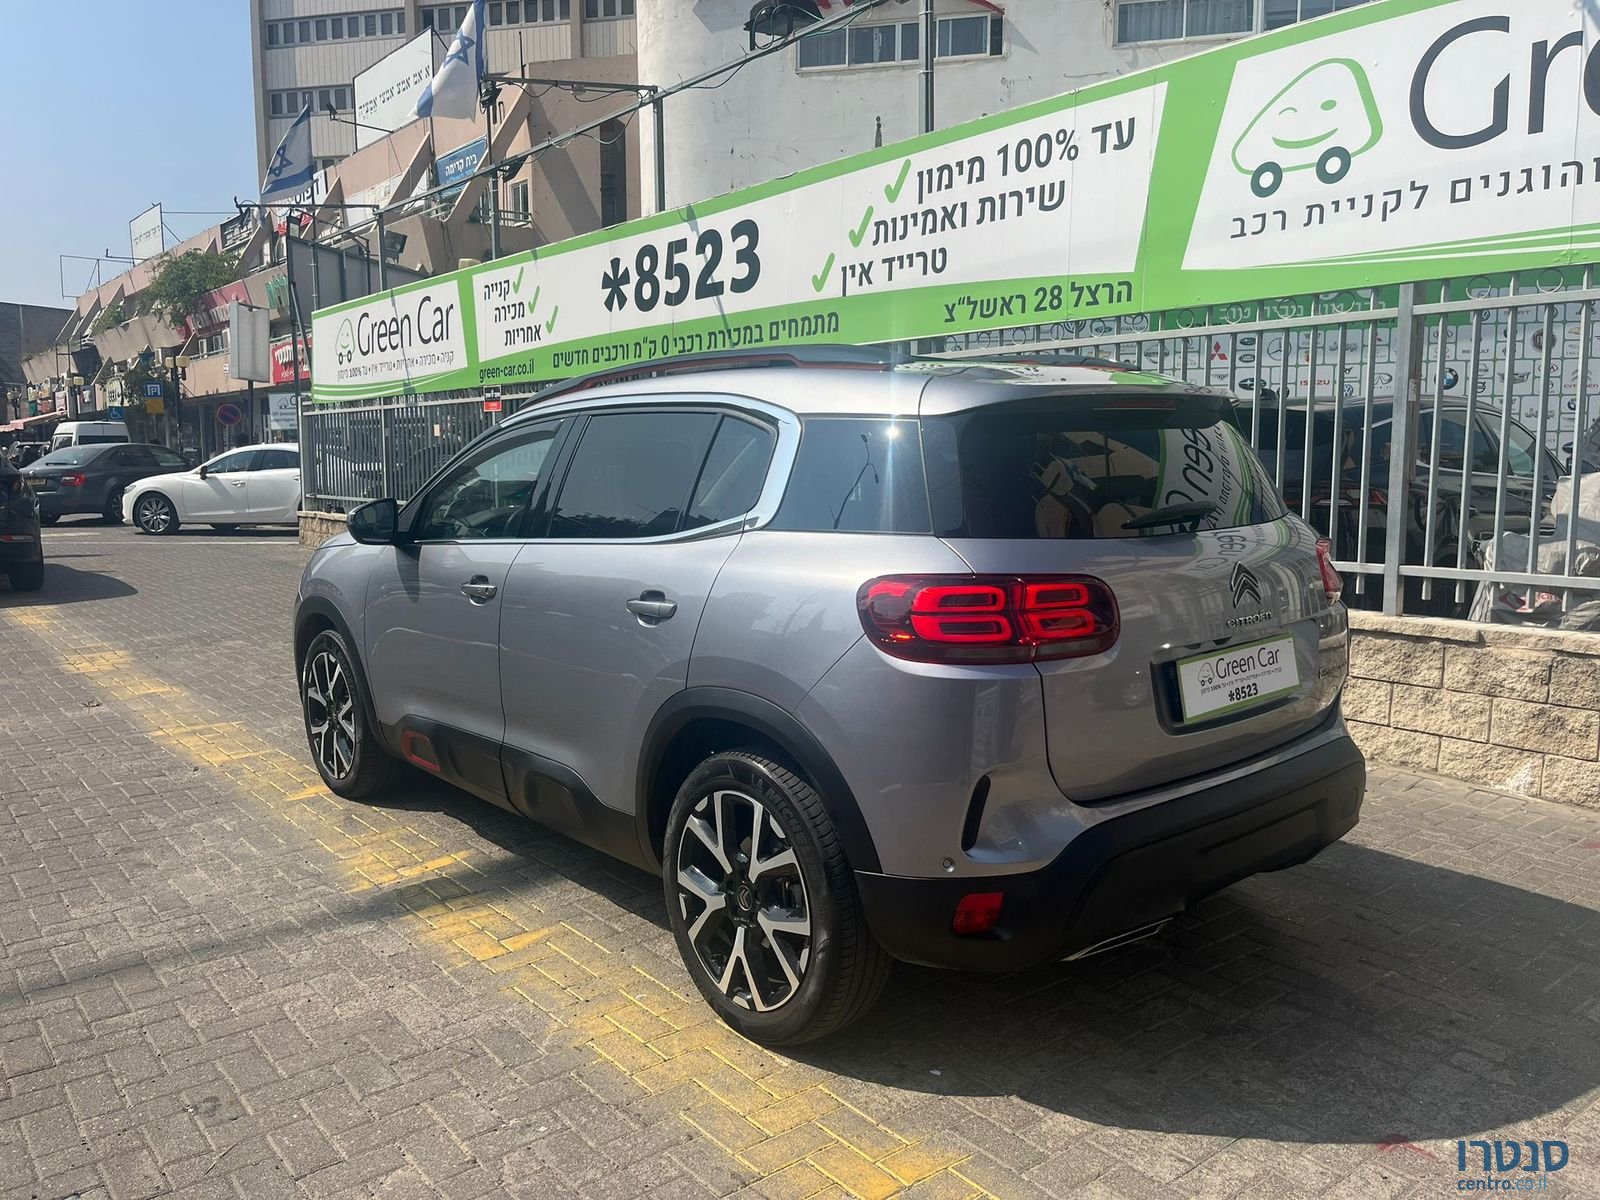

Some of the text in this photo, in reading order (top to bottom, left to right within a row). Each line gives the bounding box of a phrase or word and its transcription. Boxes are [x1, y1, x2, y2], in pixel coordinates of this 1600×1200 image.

[1408, 15, 1600, 150] Gr
[465, 154, 478, 168] בית
[917, 117, 1136, 204] עד 100% מימון
[872, 180, 1066, 246] שירות ואמינות
[1303, 180, 1429, 228] לקניית
[1230, 210, 1287, 239] רכב
[841, 247, 948, 297] טרייד אין
[484, 279, 510, 301] קנייה
[1034, 284, 1063, 311] 28
[1070, 280, 1133, 309] הרצל
[494, 300, 525, 323] מכירה
[357, 312, 411, 357] Green
[417, 296, 454, 345] Car
[504, 324, 542, 347] אחריות
[707, 323, 763, 350] במכירת
[769, 312, 840, 341] מתמחים
[592, 342, 630, 364] ורכבים
[660, 335, 670, 355] 0
[673, 333, 703, 354] רכבי
[419, 354, 436, 367] מכירה
[440, 351, 454, 367] קניה
[552, 346, 589, 368] חדשים
[349, 367, 362, 378] 100%
[479, 358, 535, 383] green-car.co.il
[1215, 647, 1280, 679] Green Car
